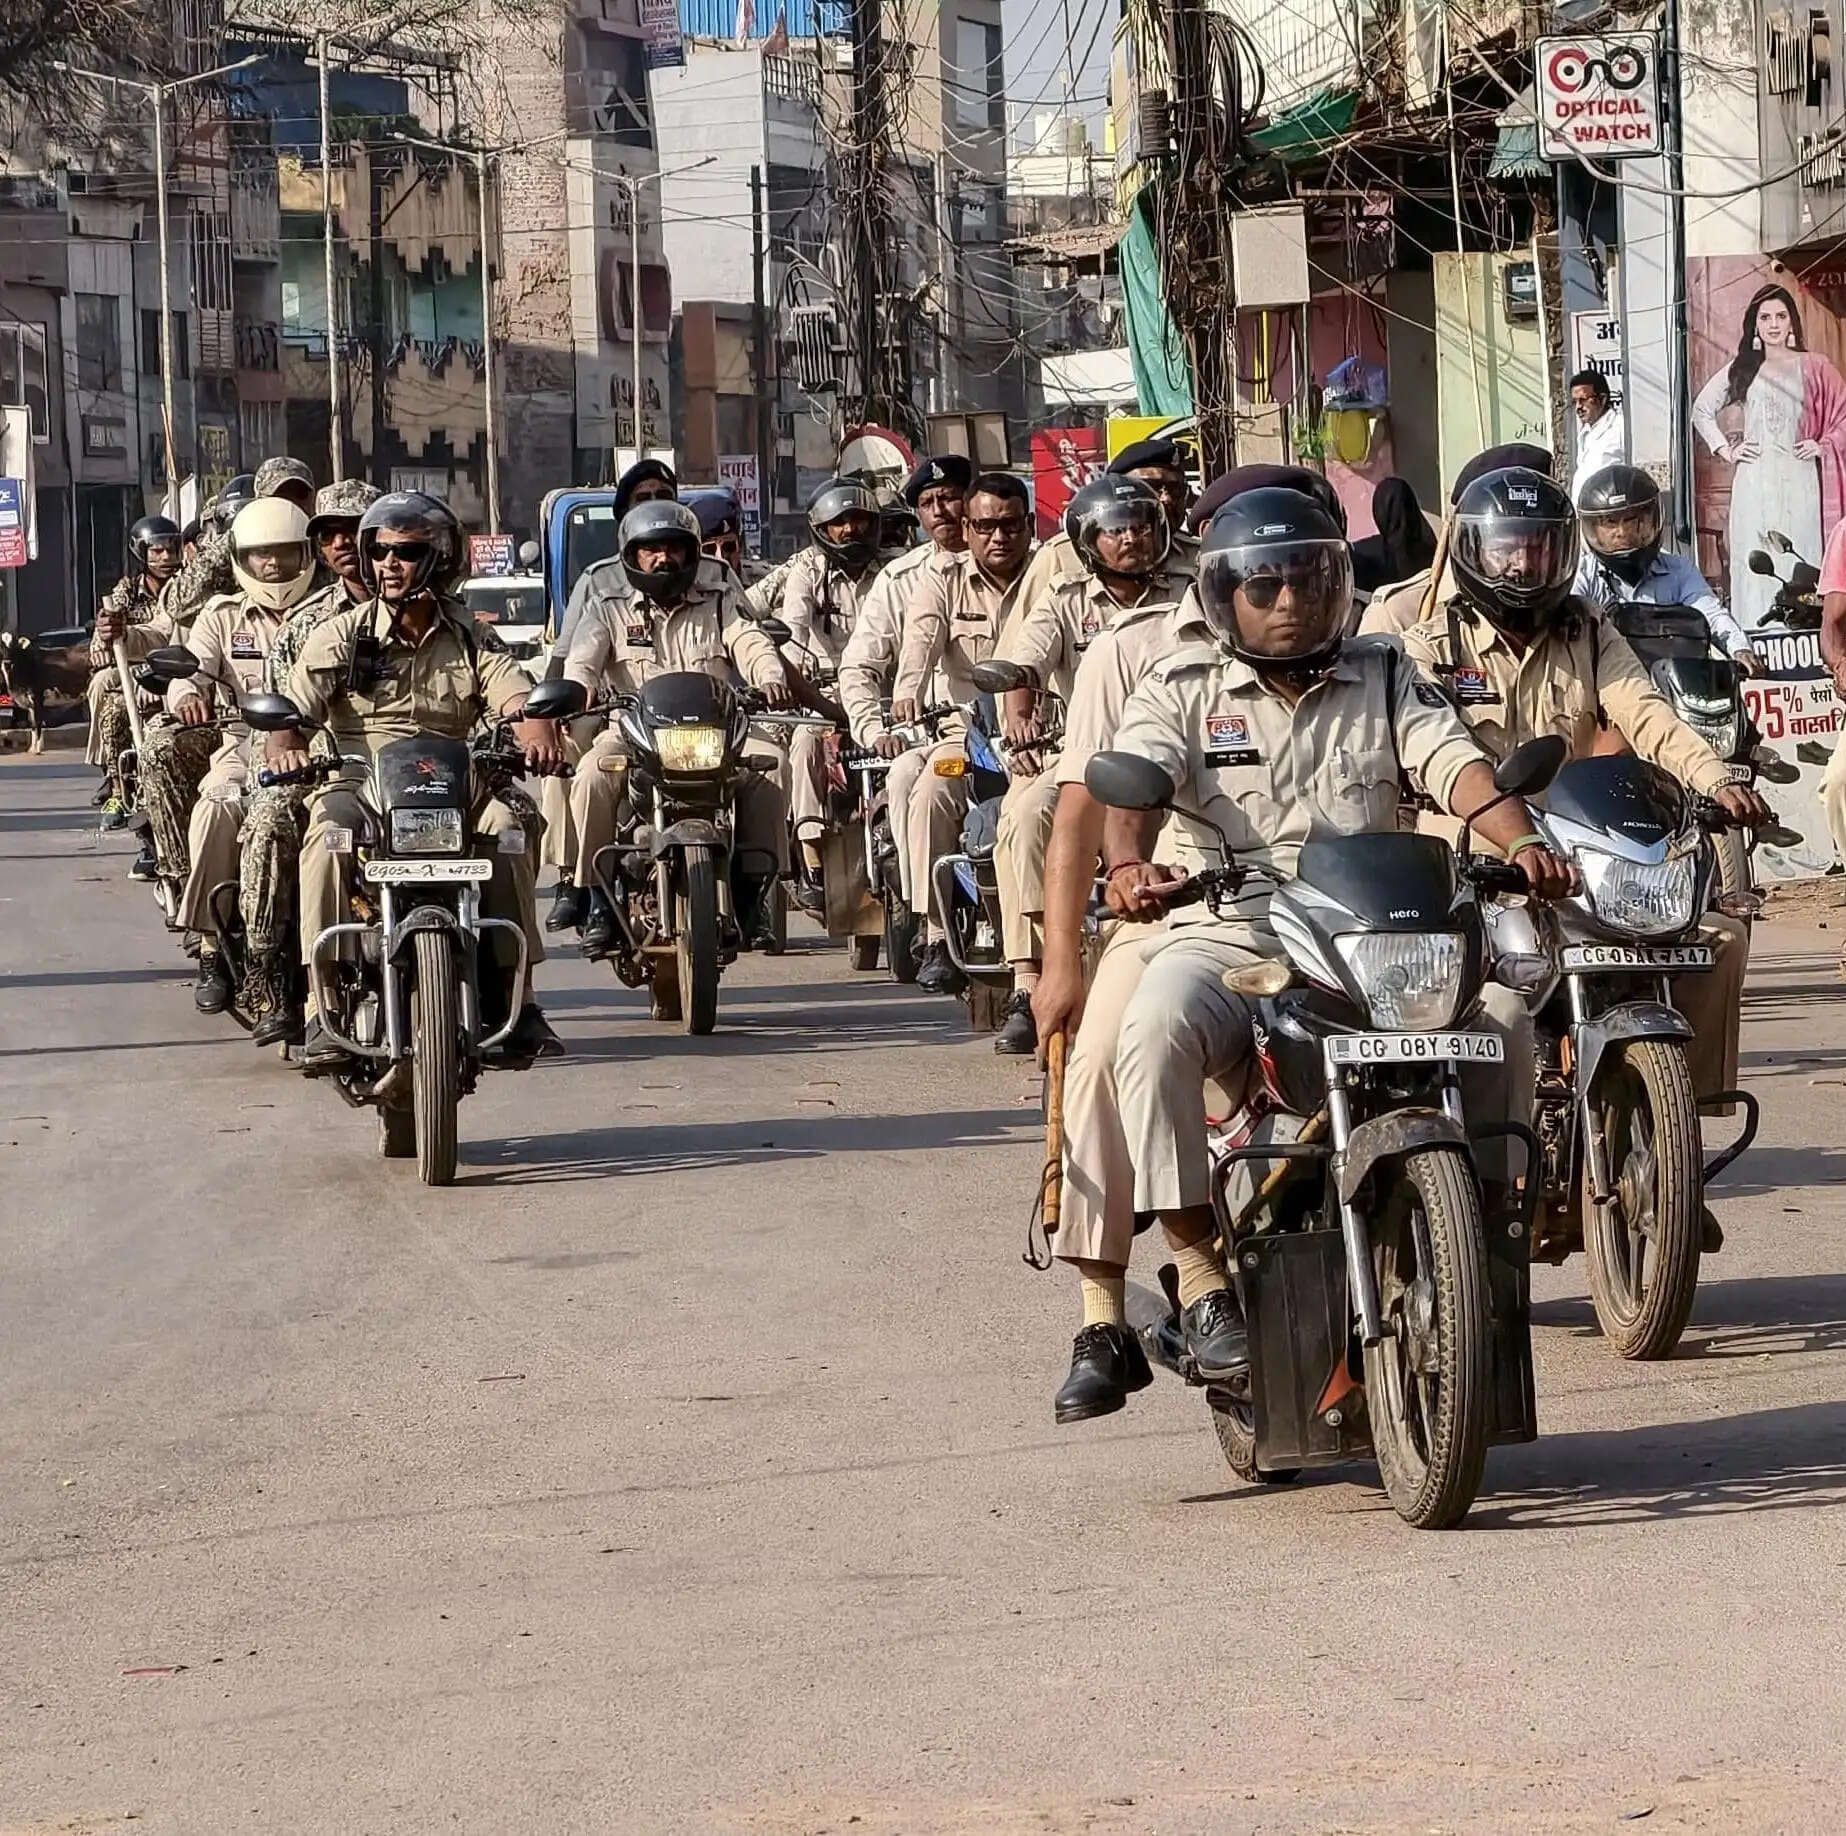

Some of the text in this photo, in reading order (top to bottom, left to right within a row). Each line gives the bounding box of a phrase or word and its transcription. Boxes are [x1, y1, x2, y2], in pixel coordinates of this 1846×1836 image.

[1555, 98, 1646, 118] OPTICAL
[1573, 124, 1651, 142] WATCH
[1359, 1036, 1497, 1058] CG 08Y 9140
